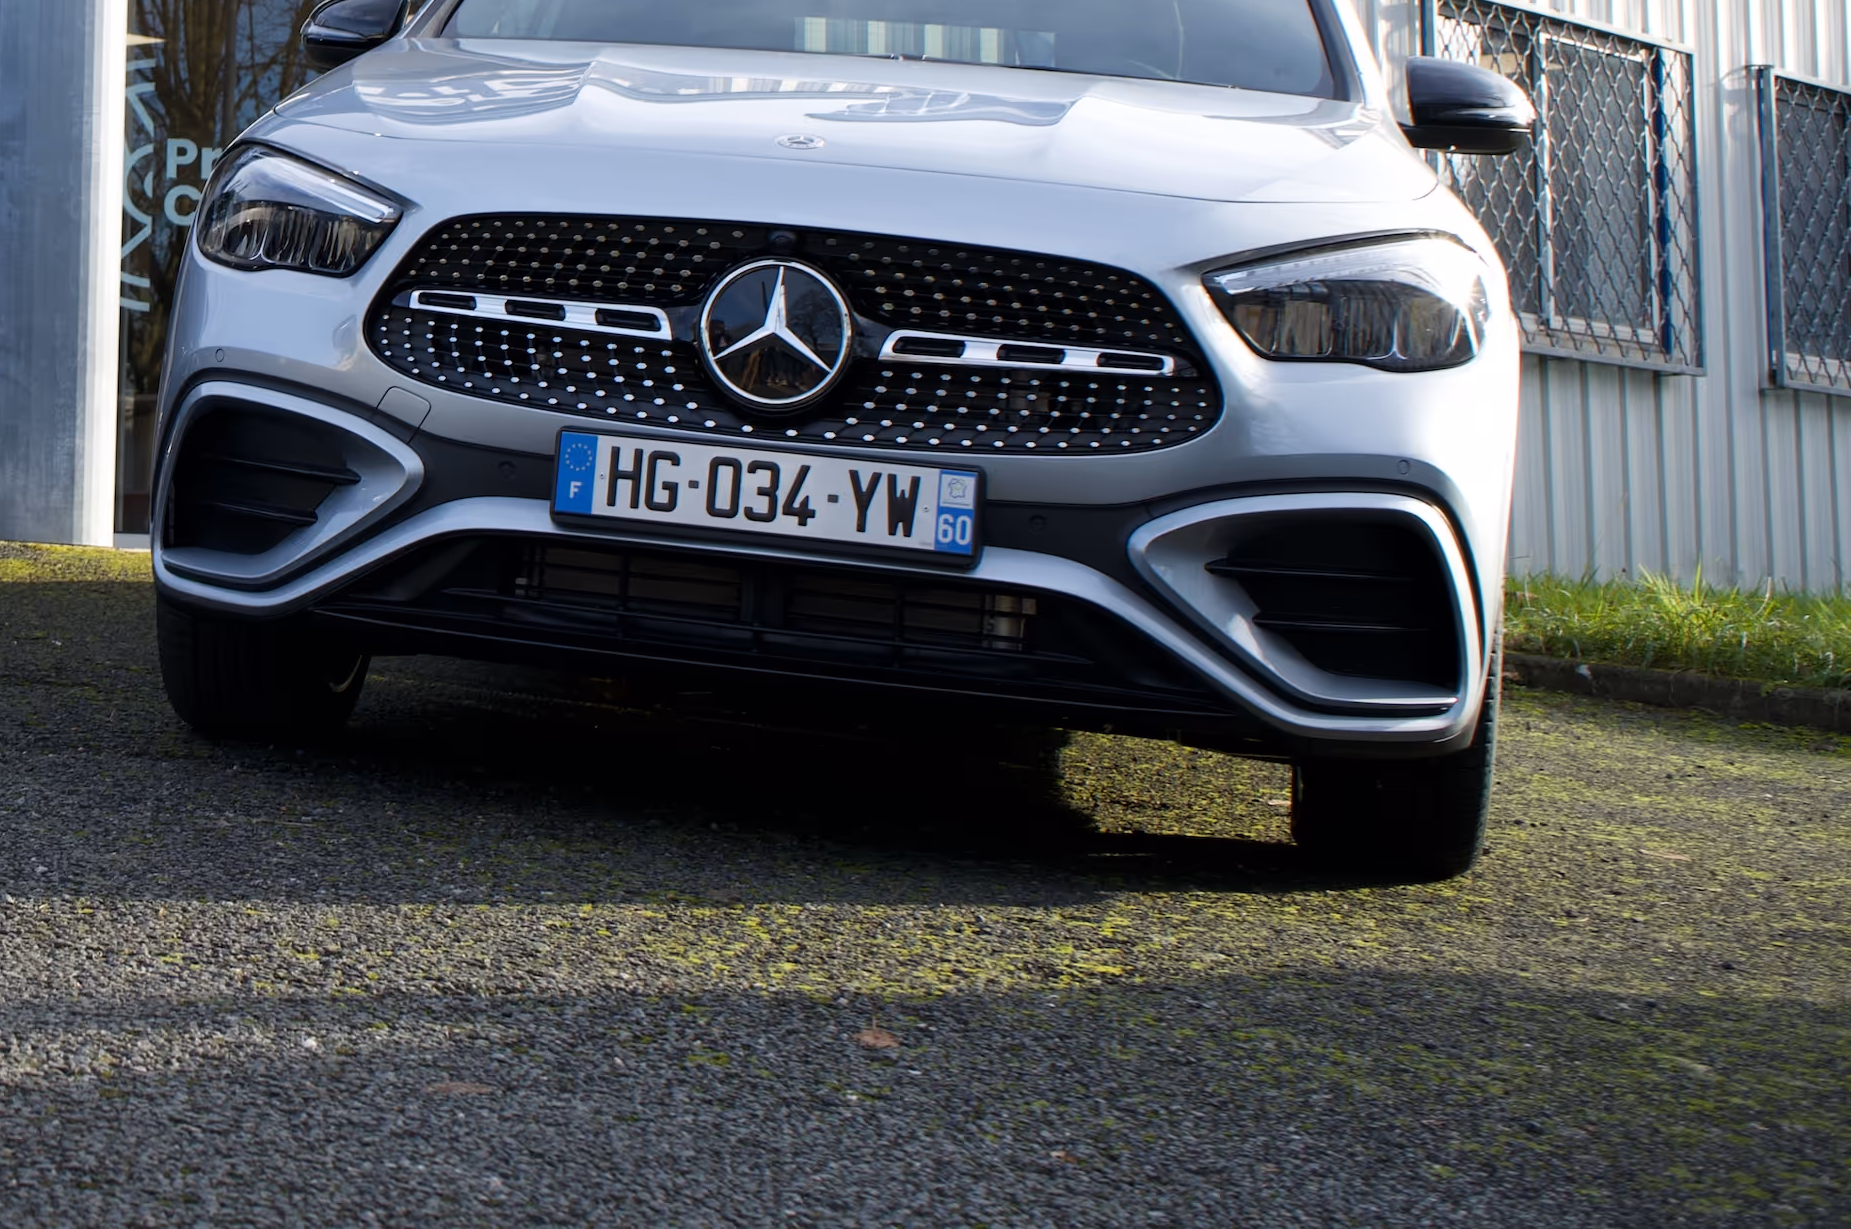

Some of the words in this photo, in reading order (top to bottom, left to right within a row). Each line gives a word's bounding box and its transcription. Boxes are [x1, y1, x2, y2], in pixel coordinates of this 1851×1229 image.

[569, 481, 582, 499] F
[606, 445, 921, 538] HG-034-YW
[937, 513, 972, 546] 60
